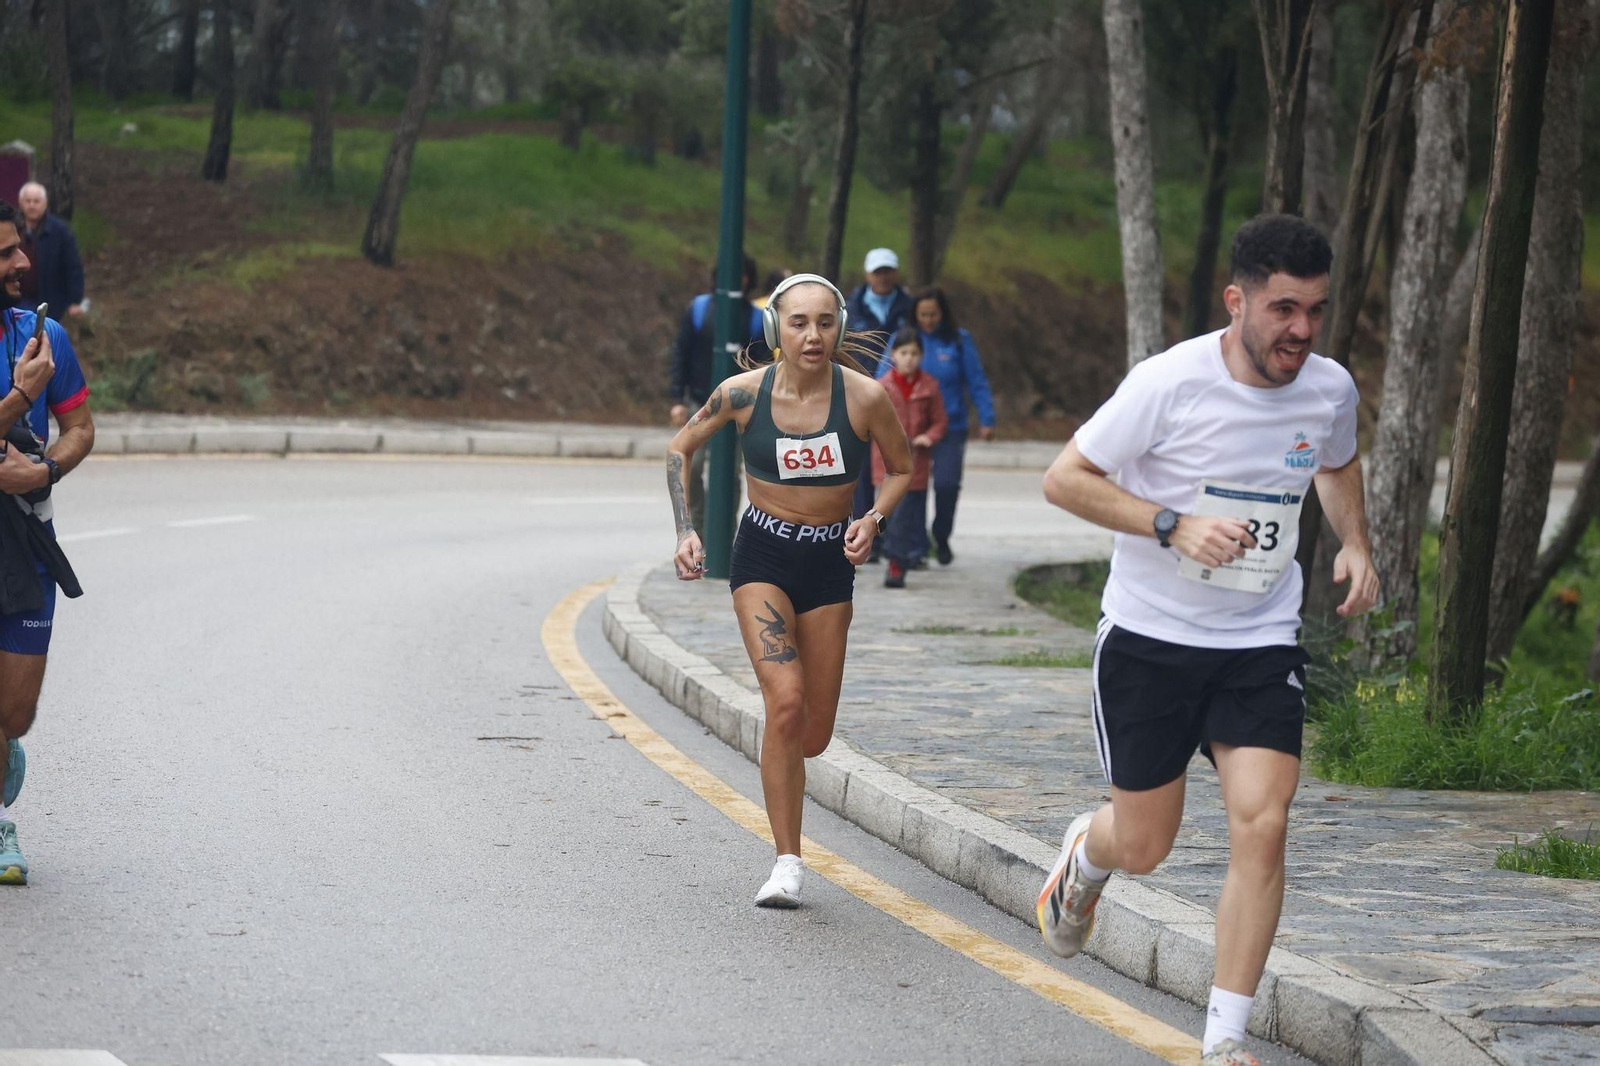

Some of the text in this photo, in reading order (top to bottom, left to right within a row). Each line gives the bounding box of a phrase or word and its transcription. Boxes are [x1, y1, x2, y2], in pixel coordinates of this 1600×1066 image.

[783, 445, 835, 470] 634
[747, 504, 843, 543] NIKE PRO
